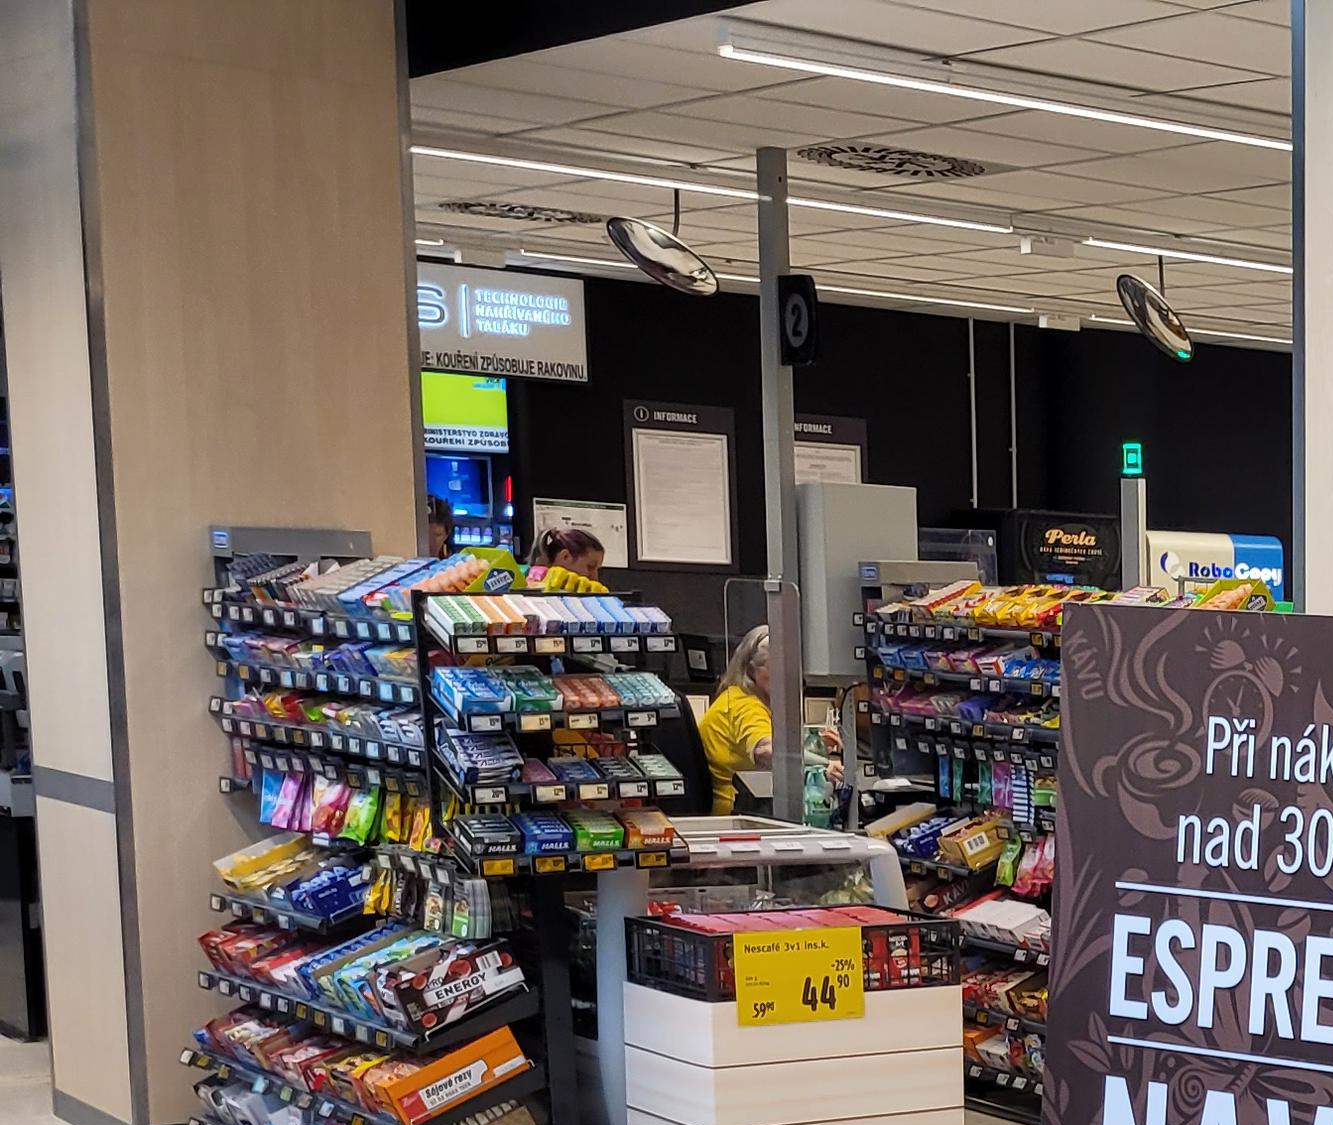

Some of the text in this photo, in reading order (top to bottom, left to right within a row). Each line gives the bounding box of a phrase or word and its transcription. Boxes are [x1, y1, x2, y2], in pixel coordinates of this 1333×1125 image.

[475, 289, 568, 311] TECHNOLOGIE
[791, 303, 803, 337] 2
[436, 350, 479, 370] KOUŘENÍ
[480, 354, 536, 375] ZPŮSOBUJE
[538, 359, 587, 380] RAKOVINU.
[653, 410, 698, 424] INFORMACE
[794, 422, 833, 434] NFORMACE
[1044, 528, 1097, 546] Perla
[1188, 561, 1282, 586] RoboCopy
[1066, 630, 1105, 699] KÁVU
[1205, 715, 1256, 778] Při
[1176, 803, 1261, 871] nad
[744, 942, 781, 953] Nescafé
[784, 942, 800, 952] 3v1
[831, 958, 855, 972] -25%
[435, 972, 487, 1001] ENERGY
